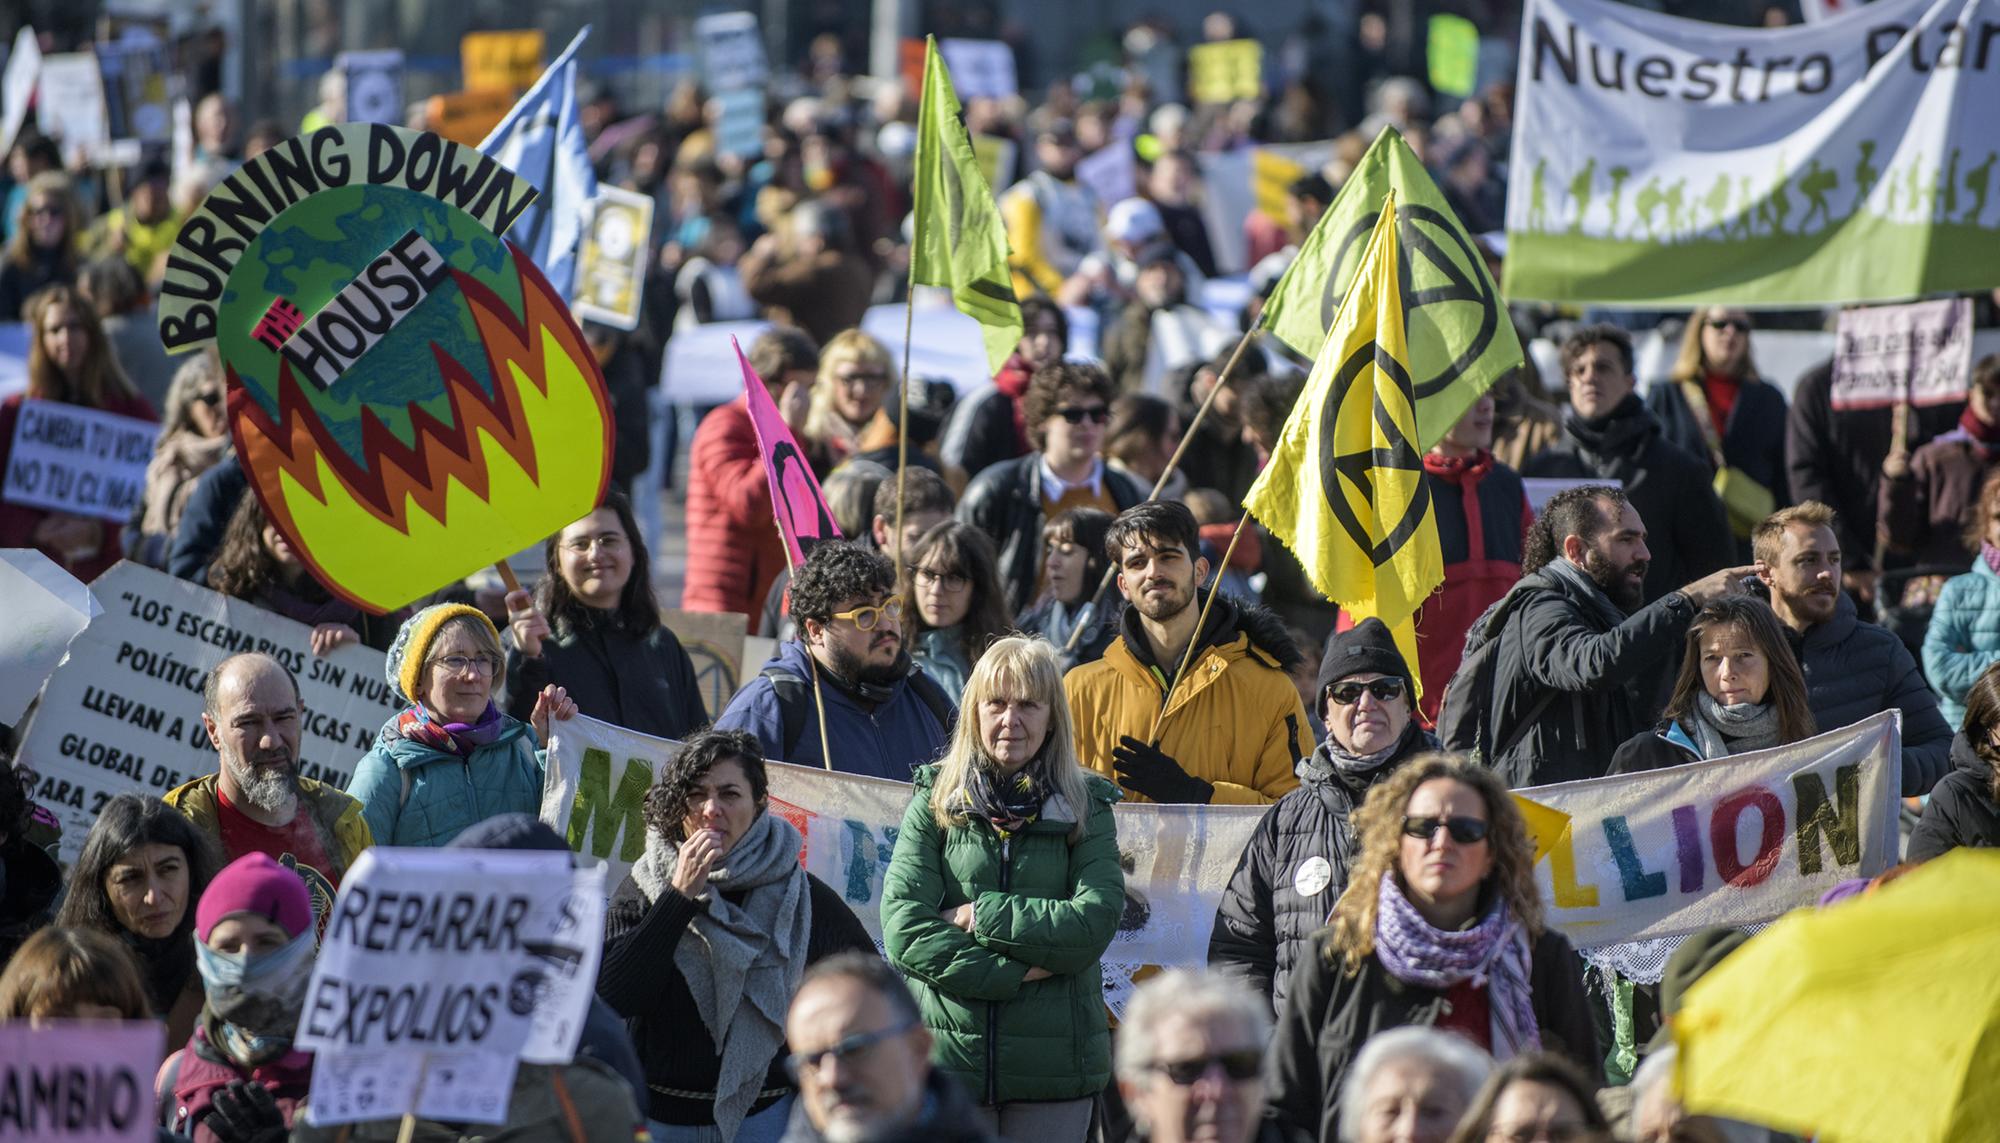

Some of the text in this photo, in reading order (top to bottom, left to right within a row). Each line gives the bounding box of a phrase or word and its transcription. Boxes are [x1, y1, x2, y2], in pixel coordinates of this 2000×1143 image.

[1531, 21, 1832, 101] Nuestro
[160, 123, 540, 349] BURNING DOWN
[255, 296, 305, 353] THE
[279, 229, 450, 392] HOUSE
[13, 459, 42, 494] NO
[45, 463, 76, 499] TU
[175, 610, 305, 674] ESCENARIOS
[308, 657, 346, 688] SIN
[80, 685, 166, 733] LLEVAN
[166, 717, 183, 741] A
[59, 733, 145, 782] GLOBAL
[149, 764, 180, 791] DE
[334, 886, 530, 951] REPARAR
[306, 976, 499, 1045] EXPOLIOS
